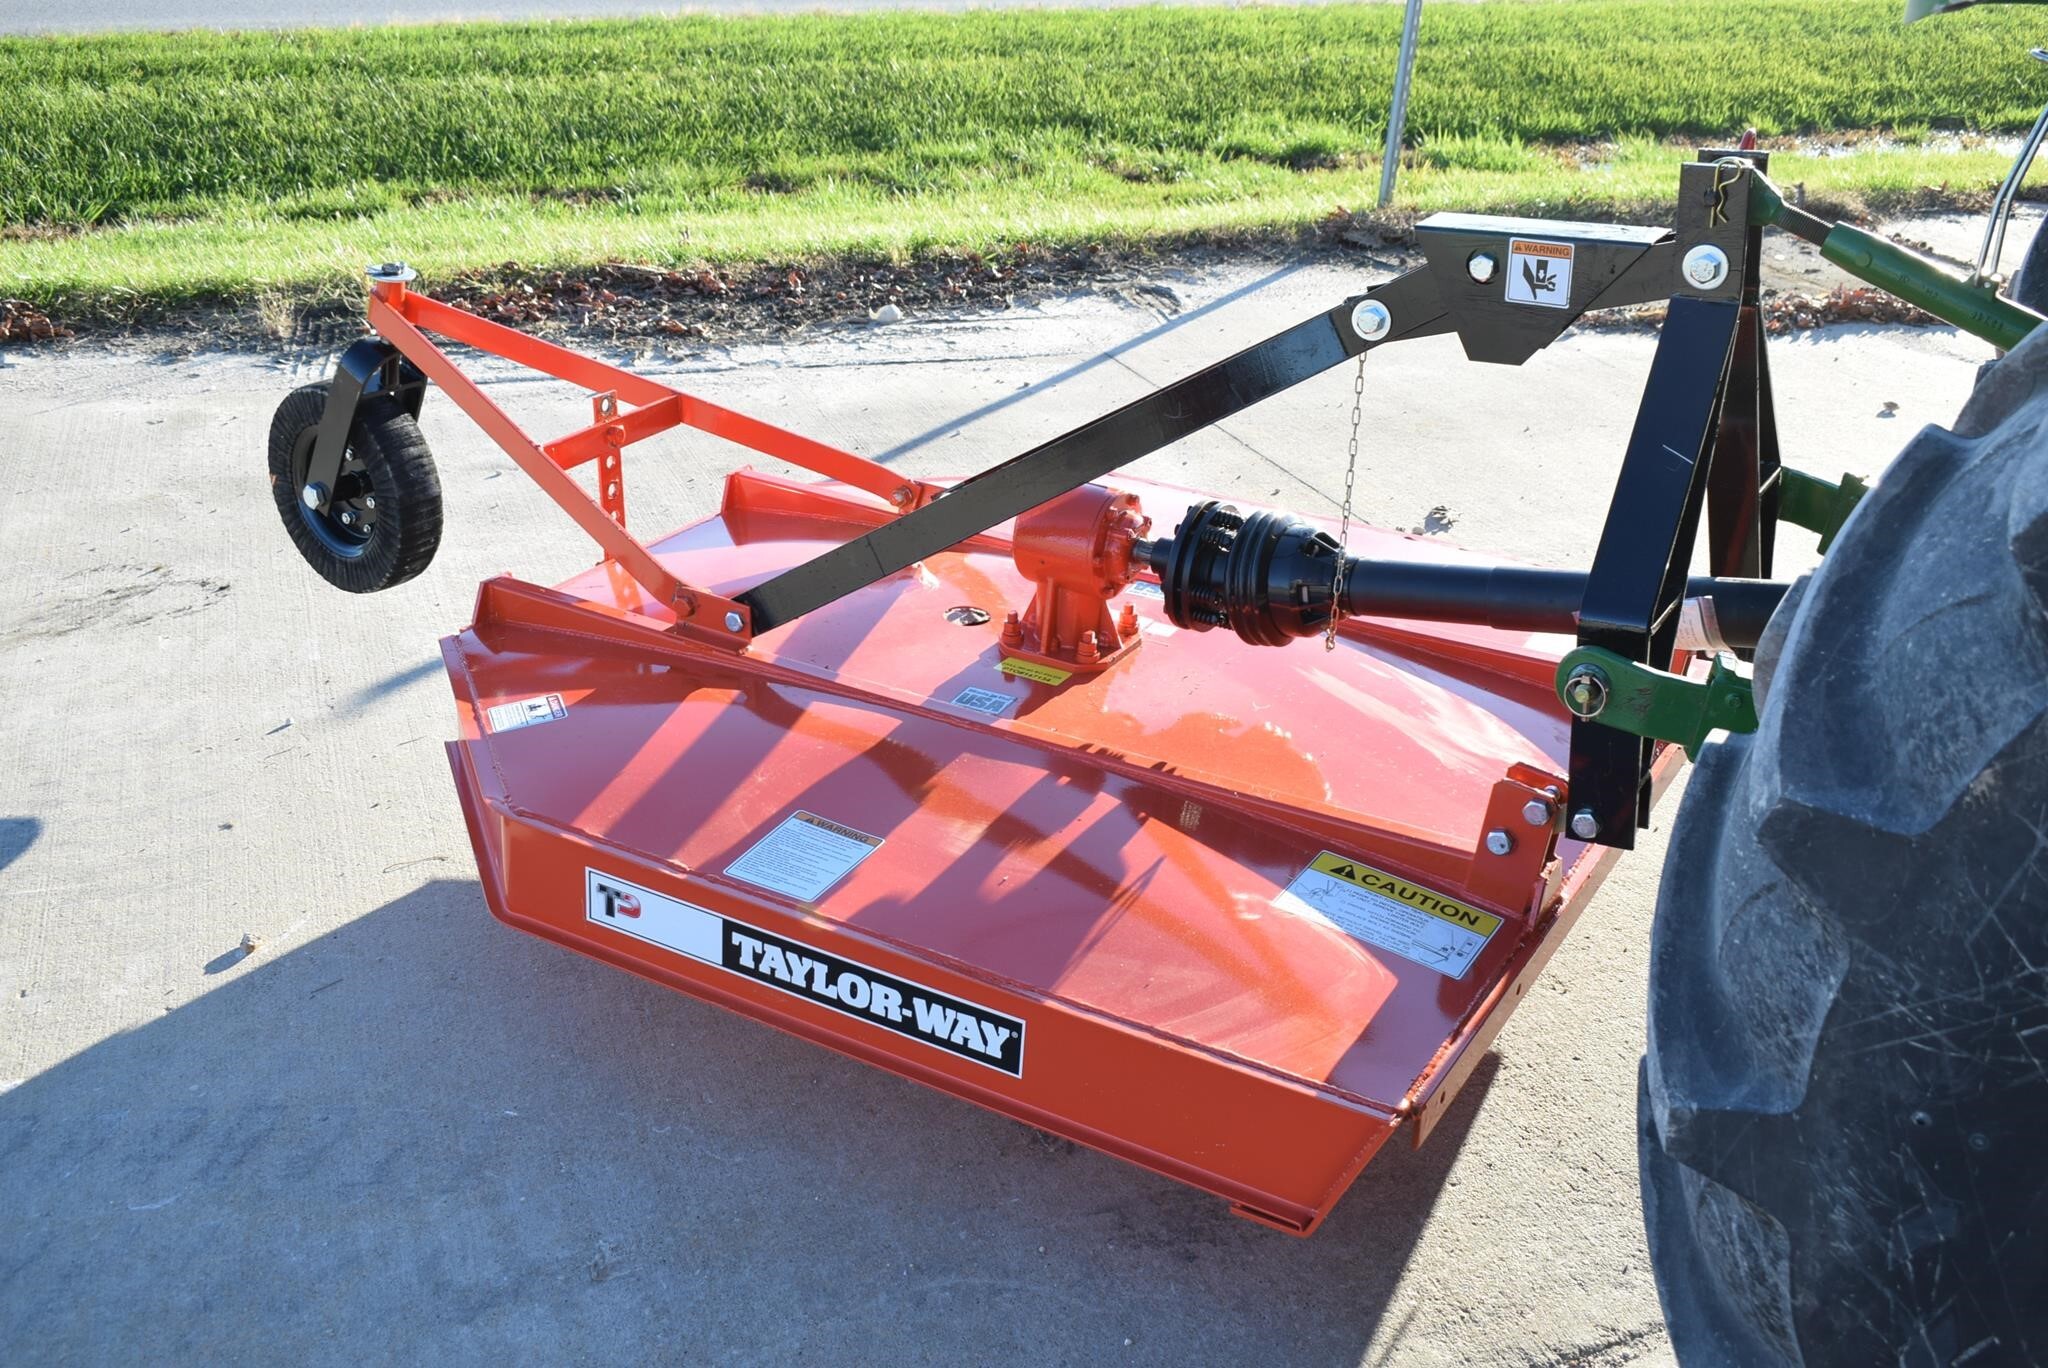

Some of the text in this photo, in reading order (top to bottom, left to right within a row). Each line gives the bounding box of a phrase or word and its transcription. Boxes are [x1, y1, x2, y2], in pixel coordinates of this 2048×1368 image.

[1524, 244, 1570, 256] WARNING
[954, 692, 1008, 712] USA
[817, 819, 871, 843] WARNING
[1361, 874, 1480, 927] CAUTION
[731, 931, 1011, 1060] TAYLOR-WAY
